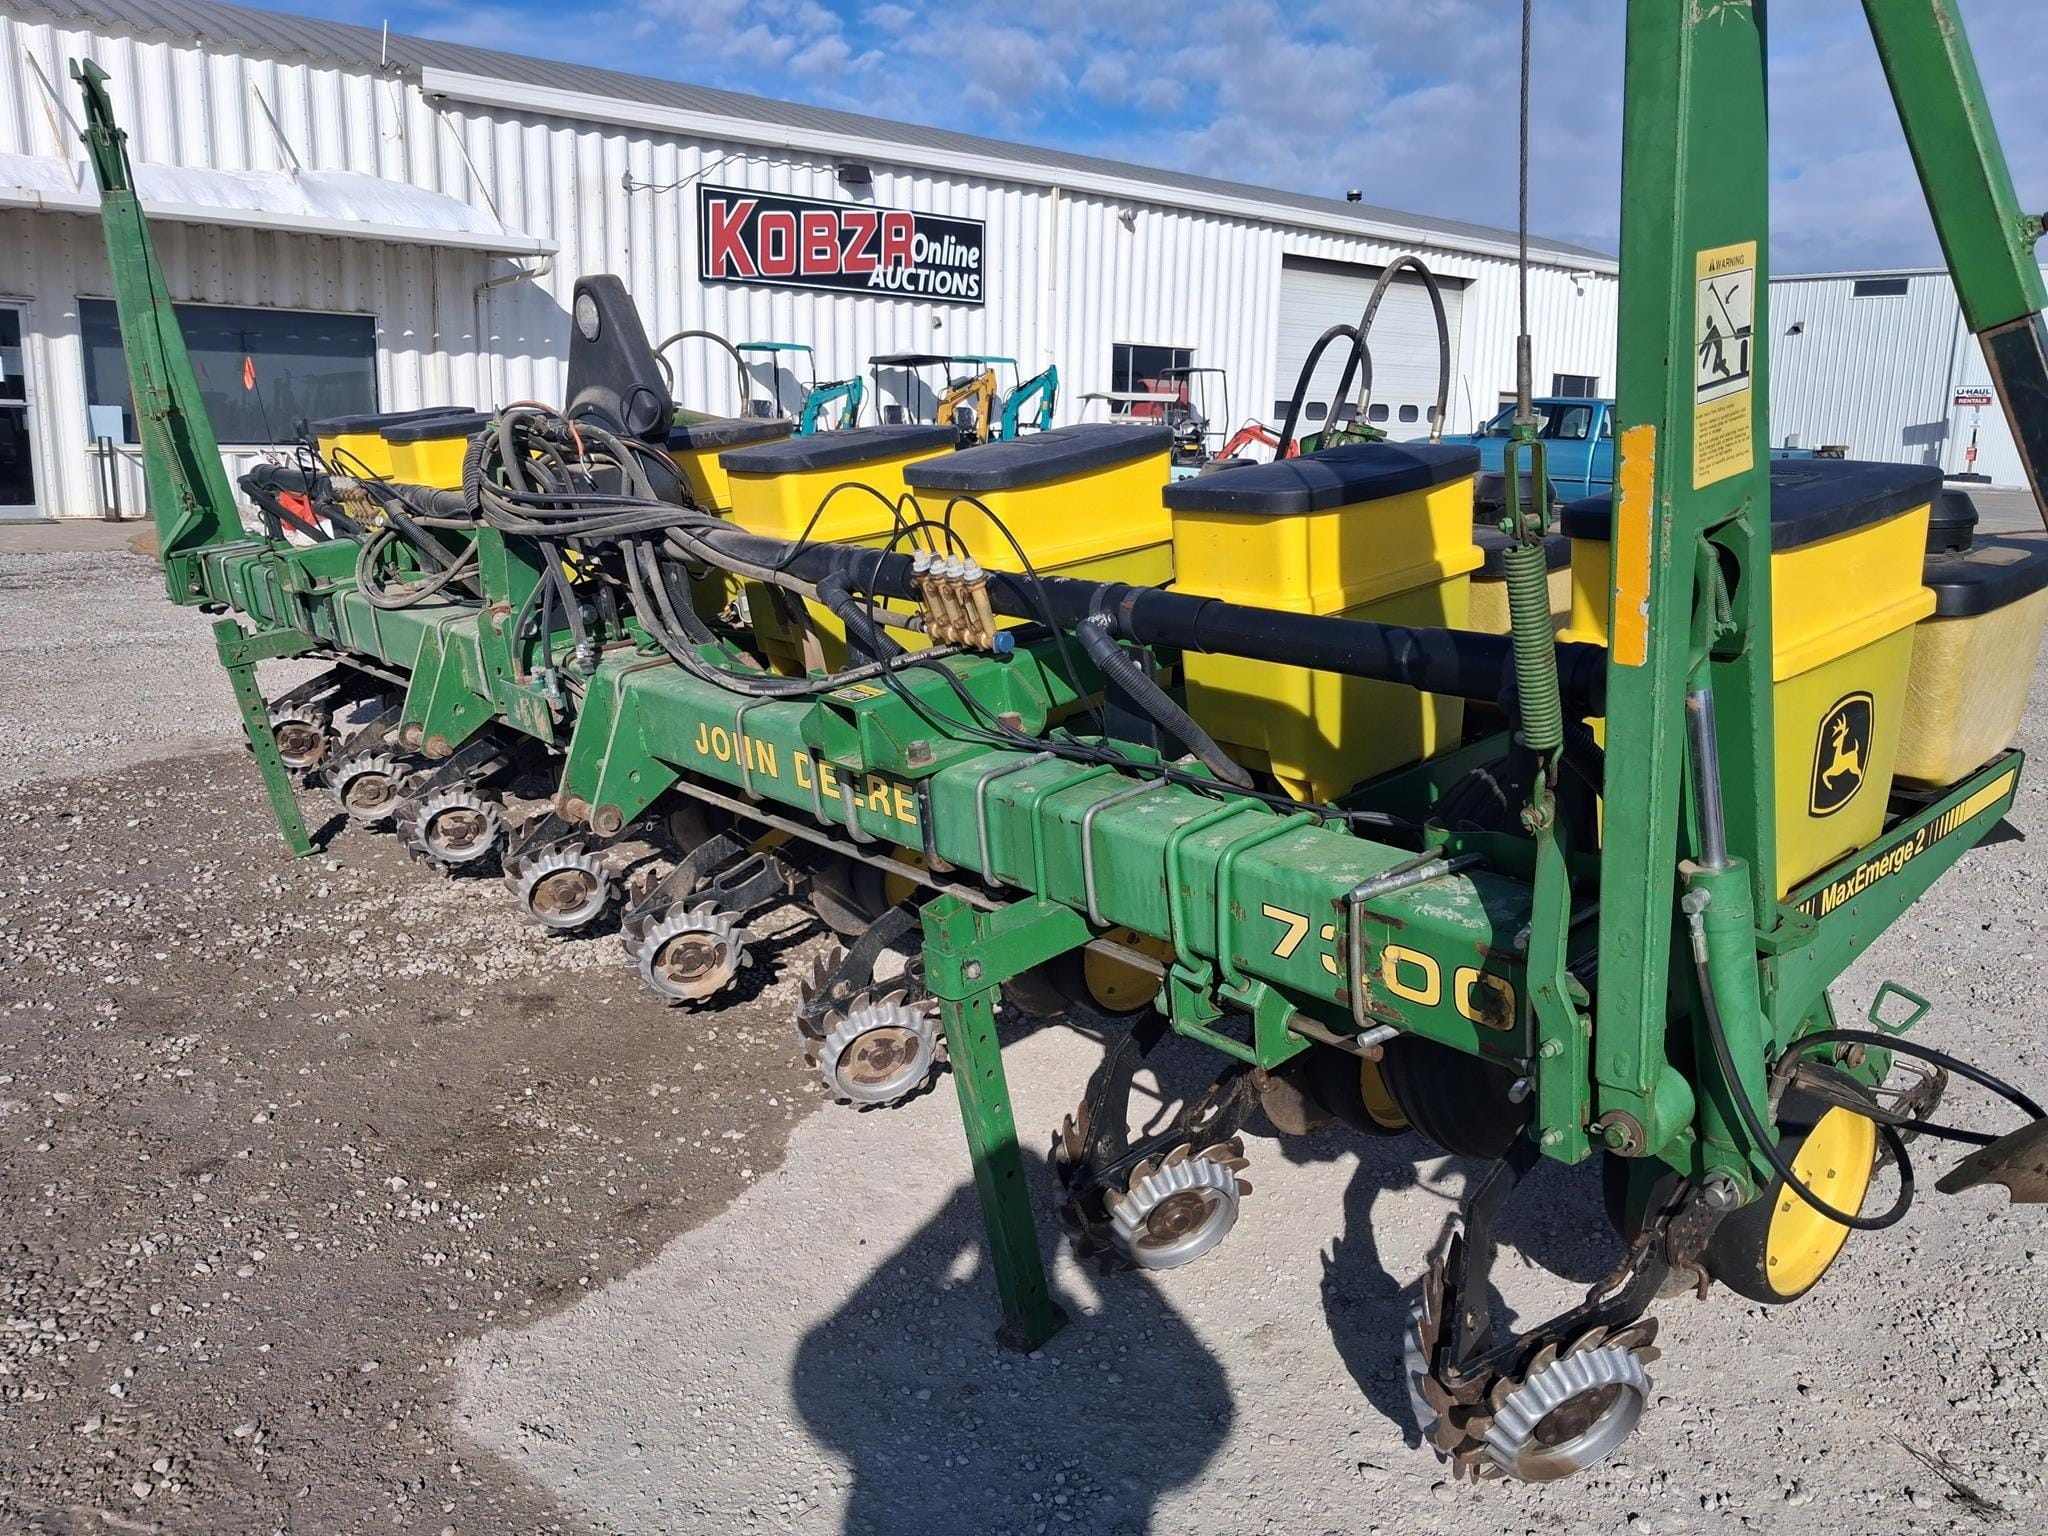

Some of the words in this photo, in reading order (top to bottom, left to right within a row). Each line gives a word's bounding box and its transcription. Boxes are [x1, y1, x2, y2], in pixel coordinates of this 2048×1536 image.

[709, 199, 915, 277] KOBZA
[910, 232, 980, 269] Online
[867, 265, 980, 297] AUCTIONS
[1715, 254, 1745, 271] WARNING
[695, 721, 779, 779] JOHN
[1820, 844, 1914, 916] MaxEmerge
[1914, 827, 1926, 854] 2
